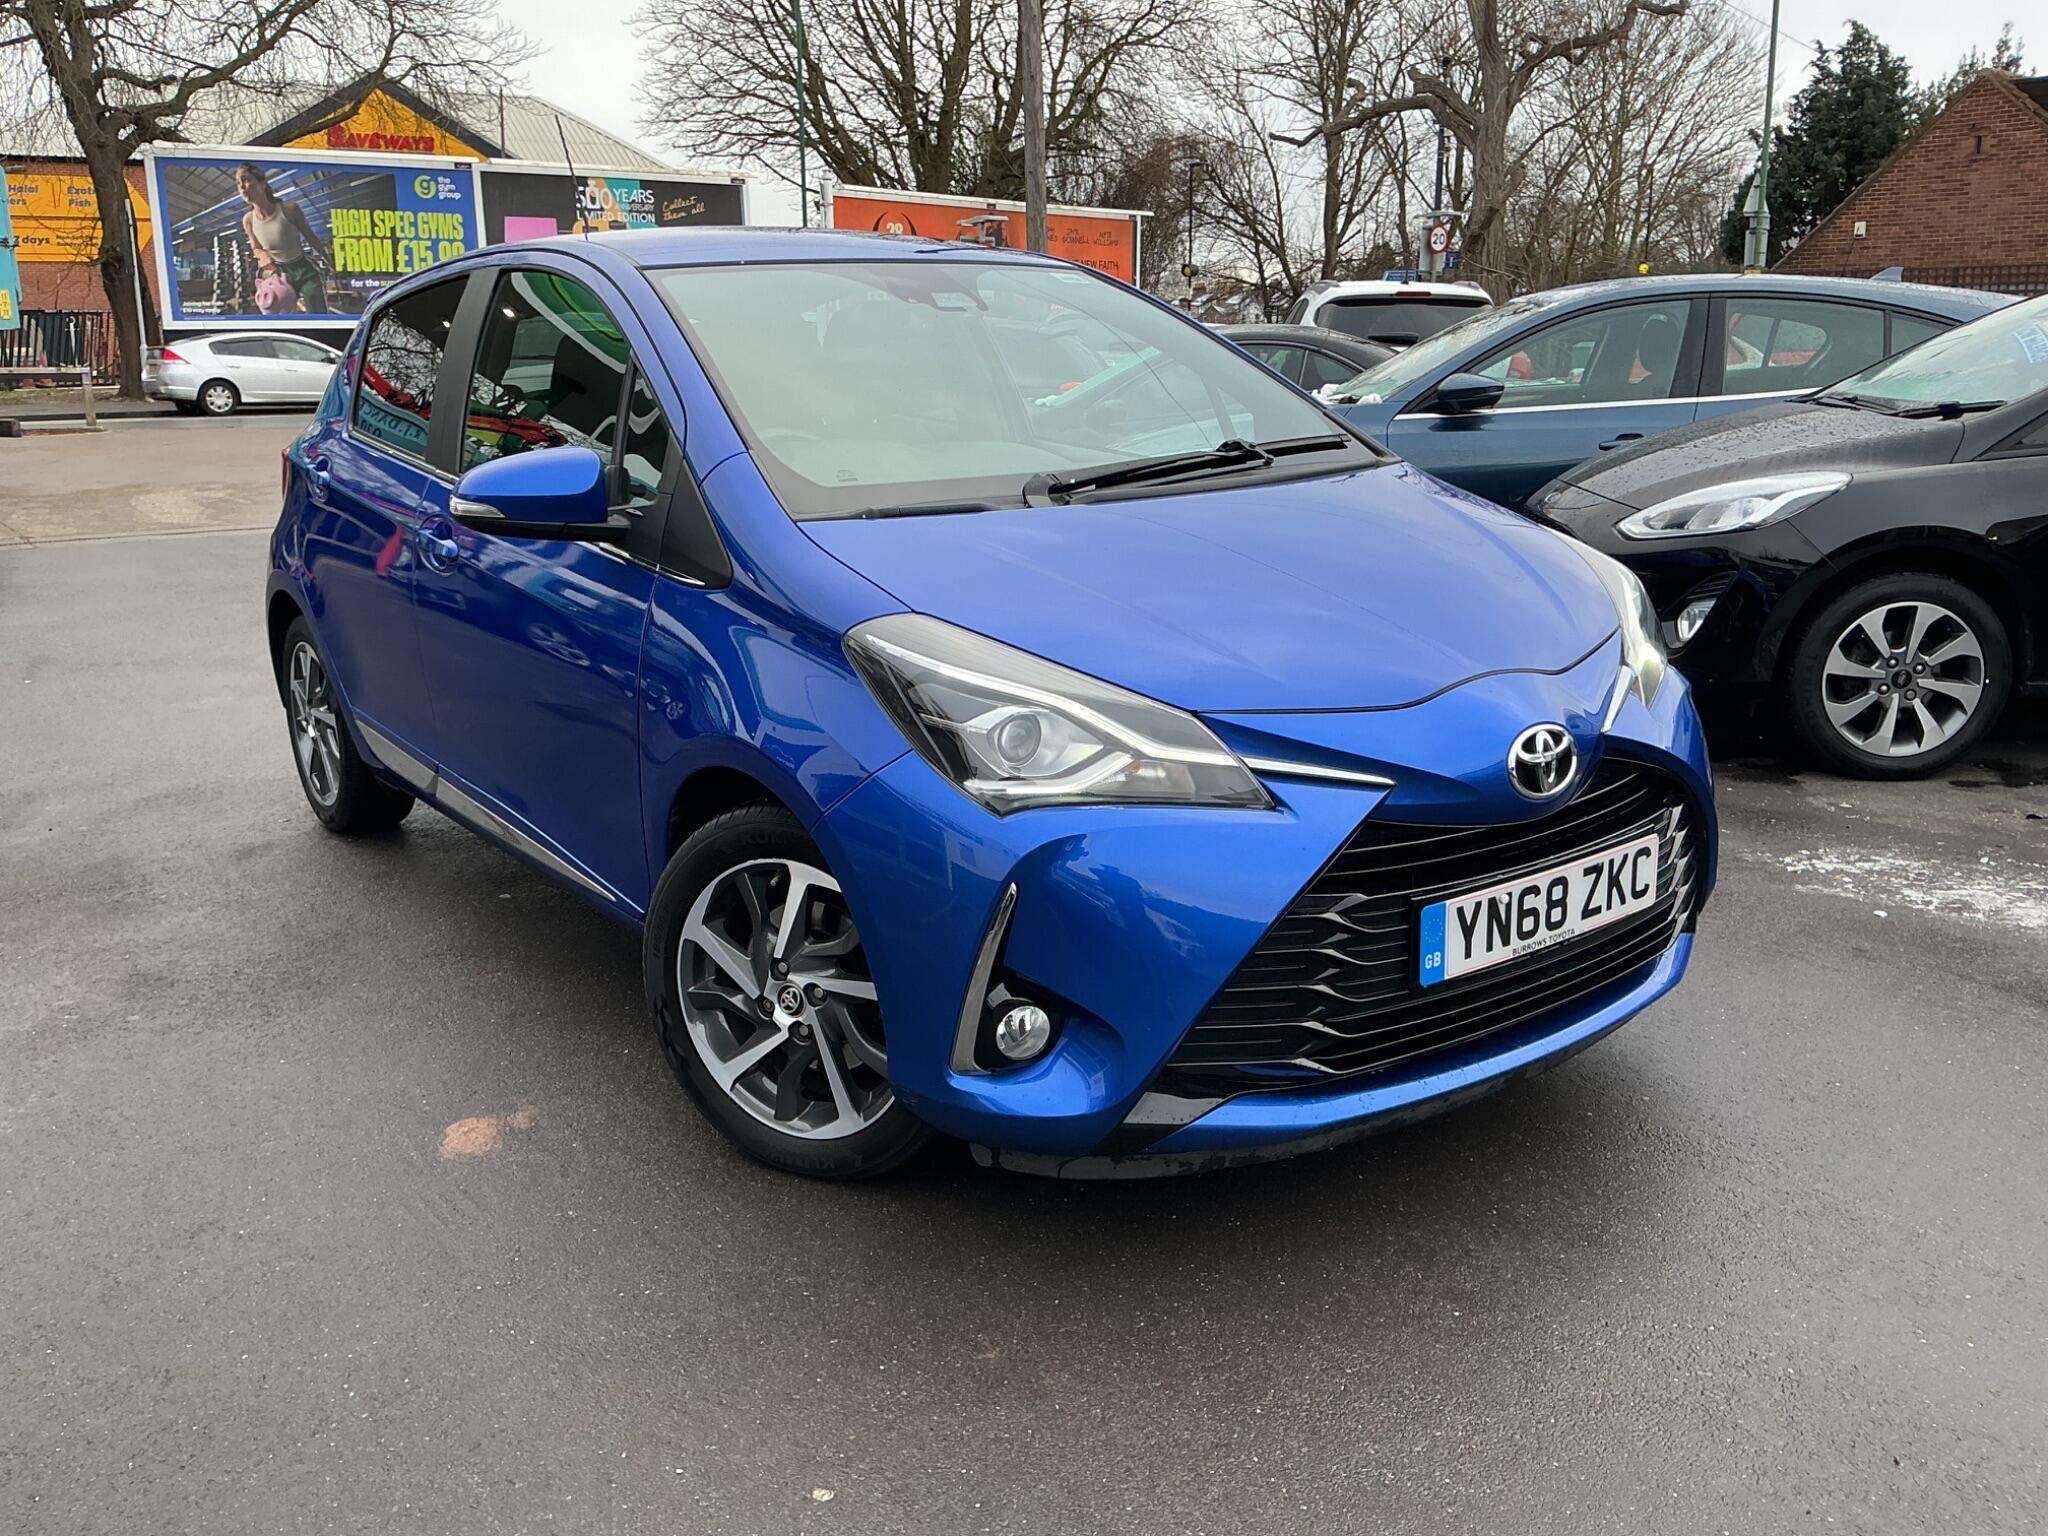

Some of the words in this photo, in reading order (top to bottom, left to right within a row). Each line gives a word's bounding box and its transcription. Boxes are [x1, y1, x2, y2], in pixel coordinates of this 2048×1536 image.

[437, 176, 451, 184] the
[438, 184, 456, 192] gym
[438, 192, 461, 200] group
[613, 188, 655, 204] YEARS
[662, 196, 697, 212] Collect
[617, 211, 656, 223] EDITION
[662, 211, 688, 221] them
[691, 202, 705, 214] all
[331, 208, 372, 237] HIGH
[373, 209, 416, 239] SPEC
[417, 212, 465, 240] GYMS
[22, 236, 50, 246] days
[1432, 233, 1444, 245] 20
[333, 237, 394, 273] FROM
[1098, 261, 1119, 271] FAITH
[350, 278, 364, 287] for
[365, 279, 380, 288] the
[1456, 875, 1569, 960] YN68
[1581, 846, 1652, 921] ZKC
[1512, 937, 1547, 957] BURROWS
[1547, 928, 1577, 944] TOYOTA
[1424, 951, 1442, 970] GB
